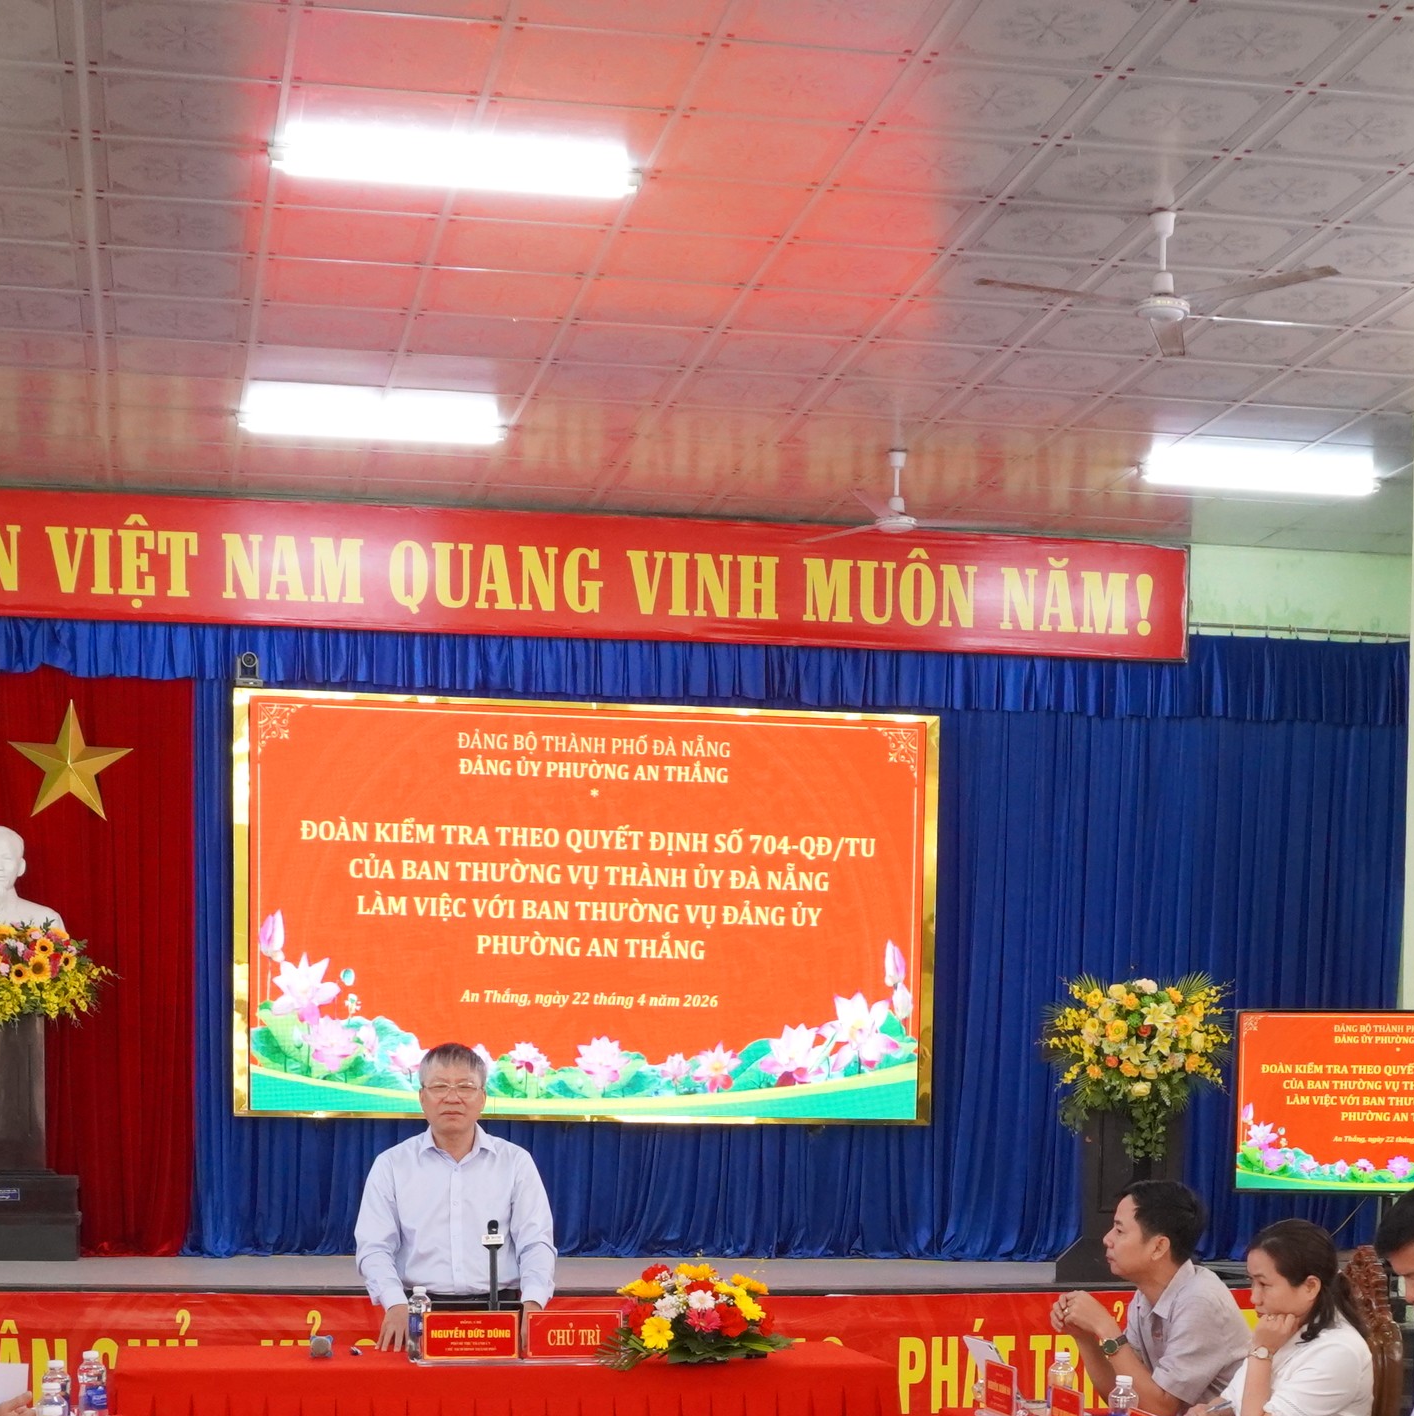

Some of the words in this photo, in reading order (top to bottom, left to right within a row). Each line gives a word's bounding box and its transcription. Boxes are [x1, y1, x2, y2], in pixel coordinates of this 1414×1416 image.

[45, 514, 198, 609] VIỆT
[222, 533, 364, 605] NAM
[386, 540, 604, 614] QUANG
[626, 550, 779, 620] VINH
[802, 547, 978, 629] MUÔN
[999, 556, 1154, 637] NĂM!
[457, 729, 508, 750] ĐẢNG
[513, 731, 538, 755] BỘ
[541, 732, 606, 754] THÀNH
[611, 734, 648, 755] PHỐ
[652, 736, 677, 756] ĐÀ
[682, 735, 730, 758] NẴNG
[459, 754, 512, 776] ĐẢNG
[516, 756, 542, 777] ỦY
[546, 759, 629, 780] PHƯỜNG
[633, 765, 660, 781] AN
[664, 760, 728, 783] THẮNG
[300, 816, 368, 842] ĐOÀN
[374, 817, 435, 844] KIỂM
[441, 825, 490, 846] TRA
[495, 826, 560, 848] THEO
[566, 824, 644, 853] QUYẾT
[648, 831, 708, 856] ĐỊNH
[714, 828, 744, 854] SỐ
[749, 834, 876, 862] 704-QĐ/TU
[349, 853, 395, 879] CỦA
[401, 860, 450, 881] BAN
[455, 858, 561, 884] THƯỜNG
[567, 865, 599, 890] VỤ
[604, 862, 687, 888] THÀNH
[693, 863, 724, 889] ỦY
[729, 865, 762, 890] ĐÀ
[767, 862, 829, 892] NẴNG
[357, 890, 407, 916] LÀM
[413, 892, 466, 922] VIỆC
[472, 894, 515, 919] VỚI
[521, 900, 569, 920] BAN
[575, 898, 679, 924] THƯỜNG
[685, 904, 716, 929] VỤ
[722, 900, 786, 926] ĐẢNG
[791, 901, 822, 927] ỦY
[477, 931, 581, 957] PHƯỜNG
[586, 938, 618, 957] AN
[624, 931, 705, 960] THẮNG
[460, 989, 480, 1002] An
[484, 988, 531, 1007] Thắng,
[535, 991, 570, 1008] ngày
[572, 992, 590, 1005] 22
[593, 992, 634, 1009] tháng
[637, 993, 646, 1006] 4
[649, 994, 680, 1007] năm
[683, 994, 718, 1008] 2026
[1286, 1094, 1310, 1105] LÀM
[1312, 1094, 1337, 1107] VIỆC
[1339, 1094, 1360, 1106] VỚI
[1362, 1096, 1385, 1106] BAN
[1341, 1110, 1391, 1122] PHƯỜNG
[1392, 1112, 1409, 1122] AN
[431, 1327, 466, 1339] NGUYỄN
[467, 1328, 485, 1339] ĐỨC
[487, 1328, 511, 1339] DŨNG
[547, 1323, 575, 1346] CHỦ
[578, 1327, 601, 1346] TRÌ
